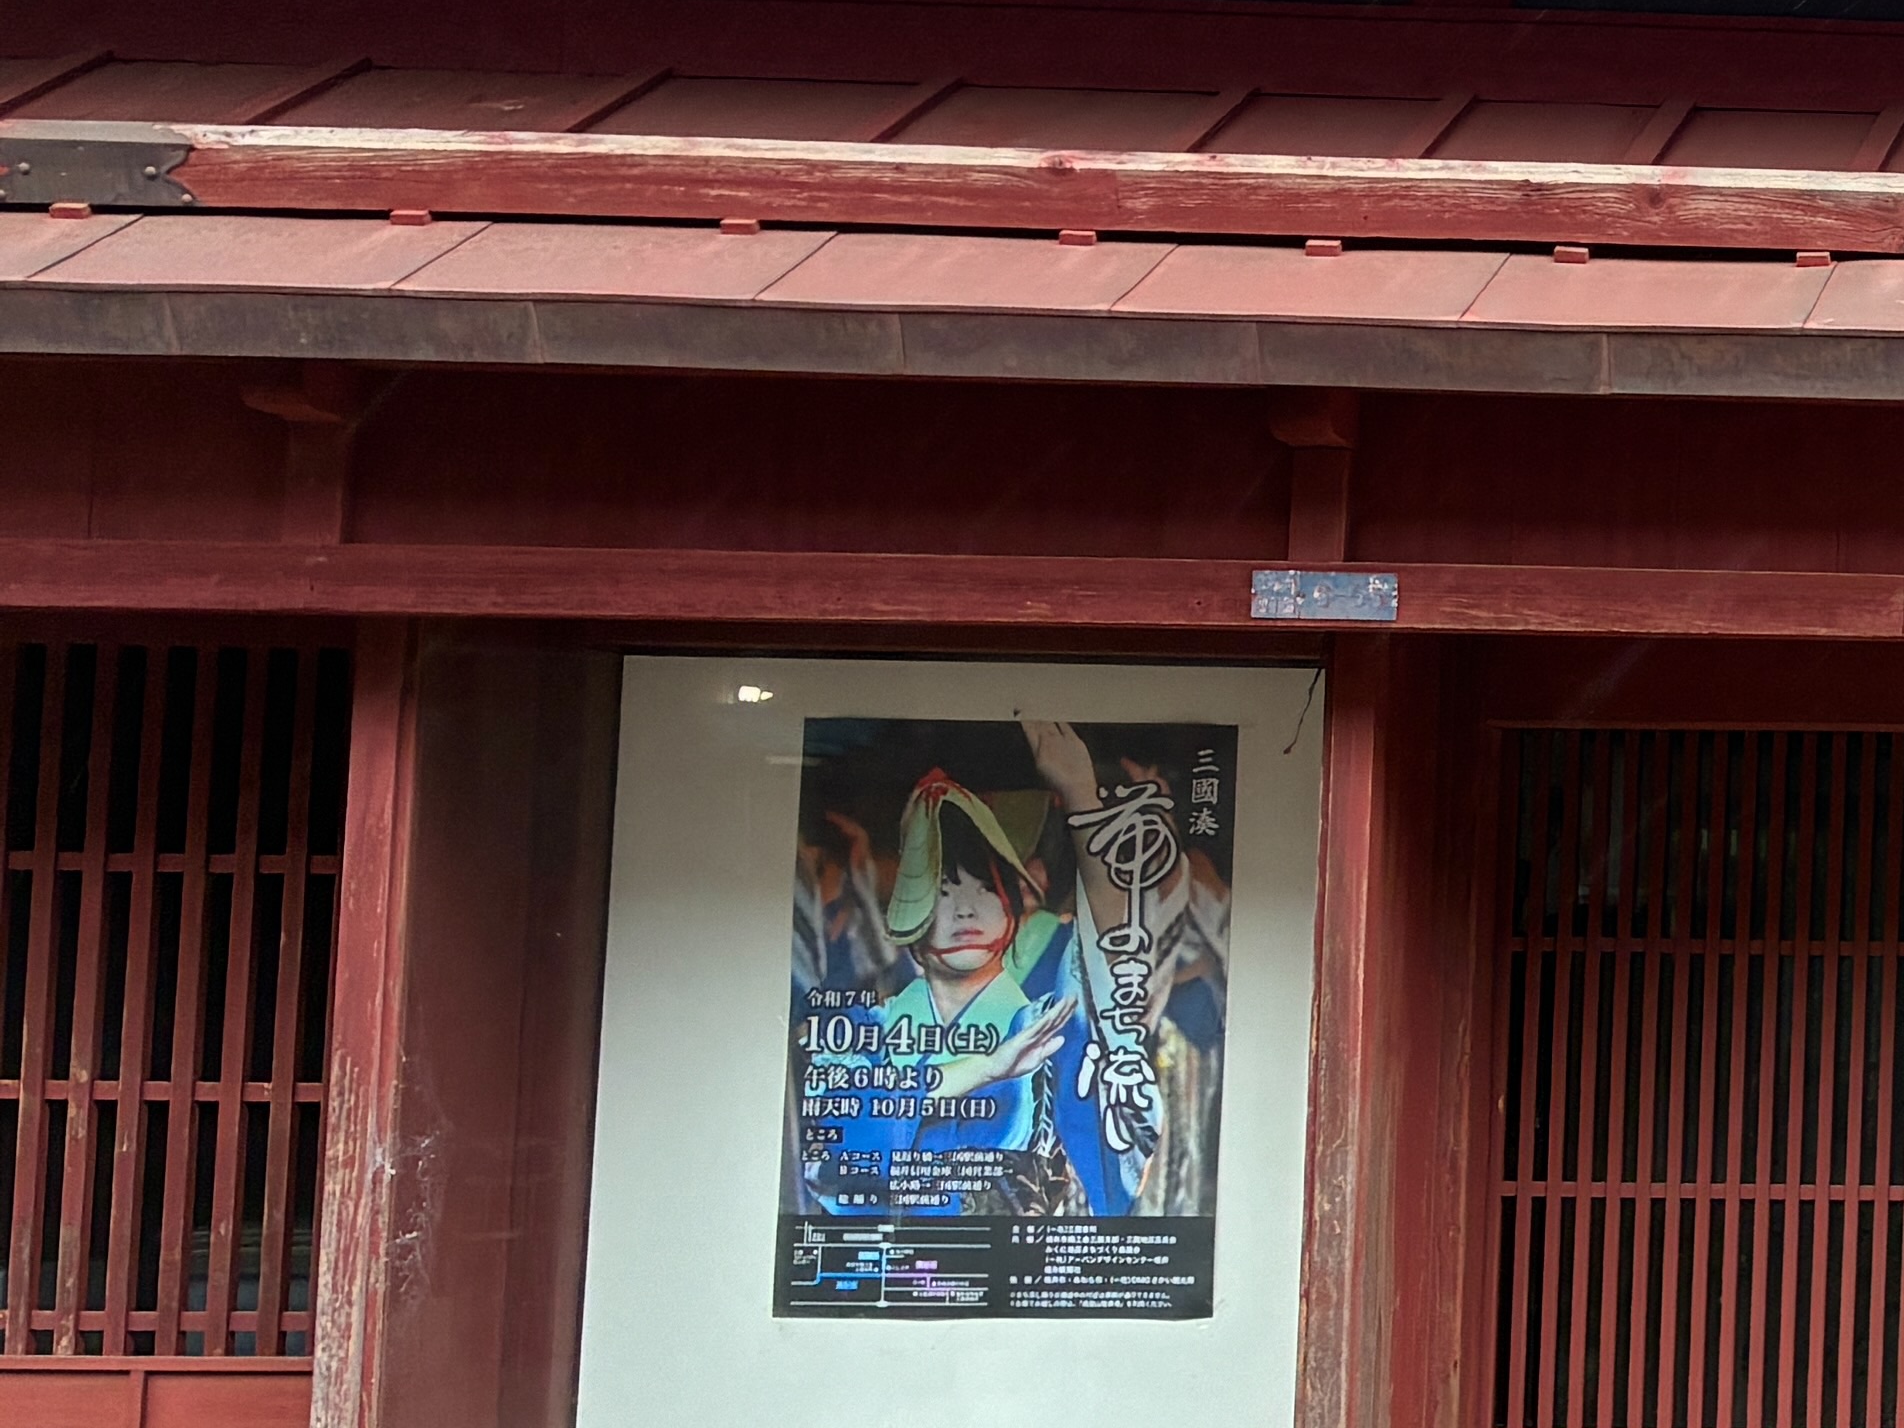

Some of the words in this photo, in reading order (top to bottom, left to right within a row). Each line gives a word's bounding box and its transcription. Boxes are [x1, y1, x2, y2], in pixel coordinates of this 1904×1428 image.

[1188, 750, 1220, 836] 三國湊
[804, 1015, 999, 1054] 10月4日(土)
[804, 1067, 943, 1090] 午後6時より
[802, 1099, 860, 1117] 雨天時
[871, 1098, 997, 1118] 10月5日(日)
[805, 1128, 838, 1141] ところ
